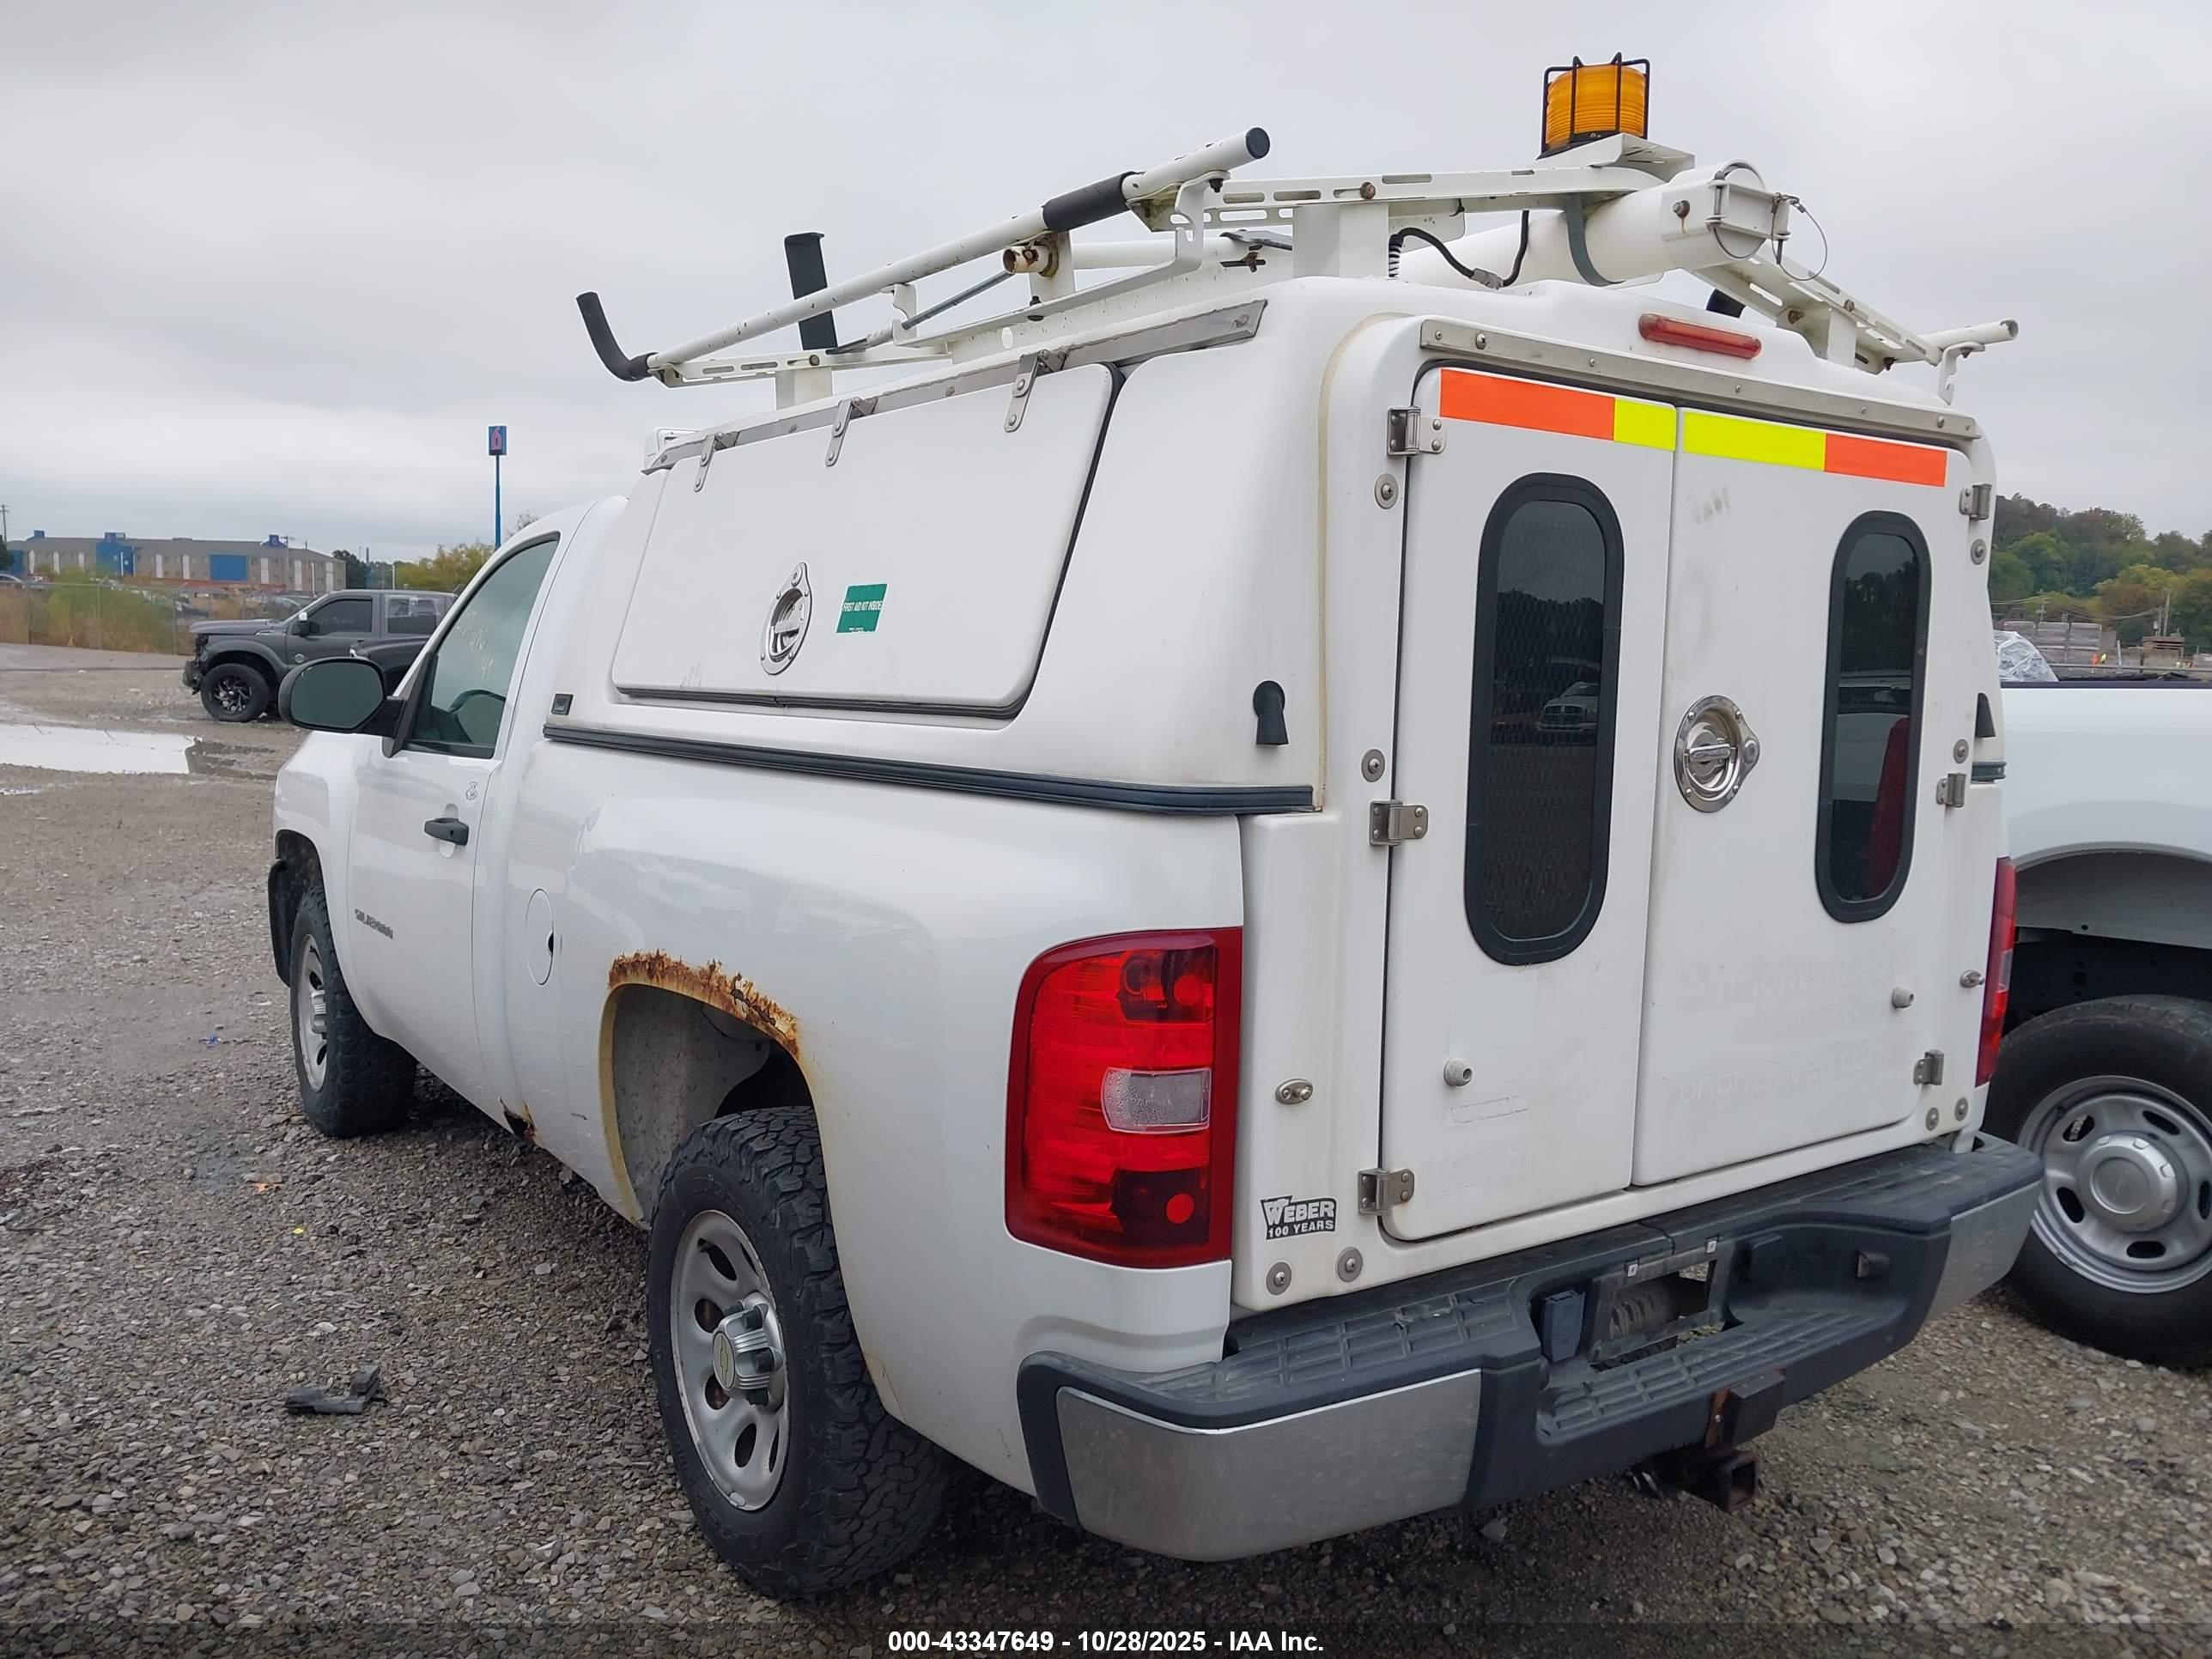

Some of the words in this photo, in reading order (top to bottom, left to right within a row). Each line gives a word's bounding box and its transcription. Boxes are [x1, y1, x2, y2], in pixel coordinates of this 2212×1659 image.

[490, 427, 502, 451] 6
[1262, 1198, 1335, 1226] WEBER
[1268, 1225, 1289, 1238] 100
[1293, 1219, 1334, 1234] YEARS
